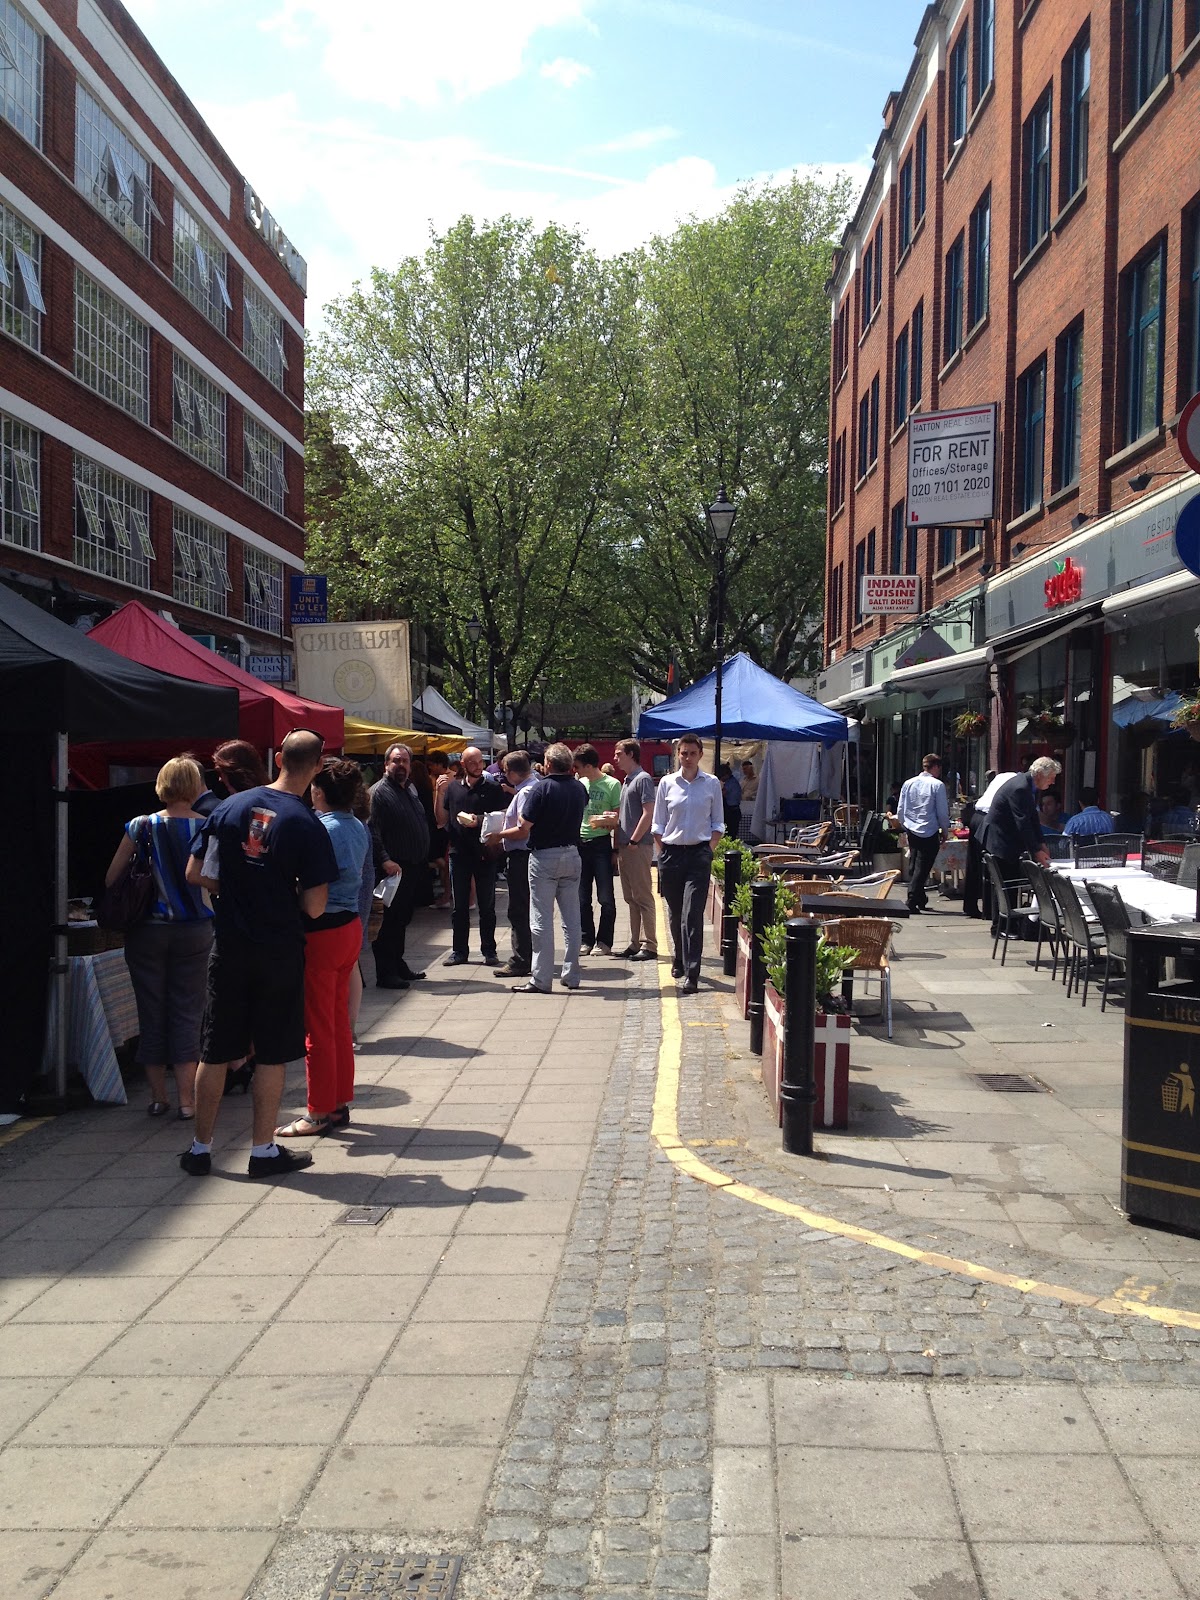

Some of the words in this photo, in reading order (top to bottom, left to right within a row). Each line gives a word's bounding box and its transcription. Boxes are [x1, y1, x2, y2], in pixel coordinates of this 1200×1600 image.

[913, 422, 941, 433] HATTON
[943, 418, 962, 429] REAL
[965, 414, 991, 426] ESTATE
[913, 445, 942, 464] FOR
[948, 439, 990, 460] RENT
[912, 462, 989, 478] Offices/Storage
[911, 483, 931, 497] 020
[934, 480, 959, 494] 7101
[963, 476, 990, 491] 2020
[867, 579, 916, 589] INDIAN
[866, 589, 916, 597] CUISINE
[252, 656, 288, 664] INDIAN
[251, 665, 288, 673] CUISINE
